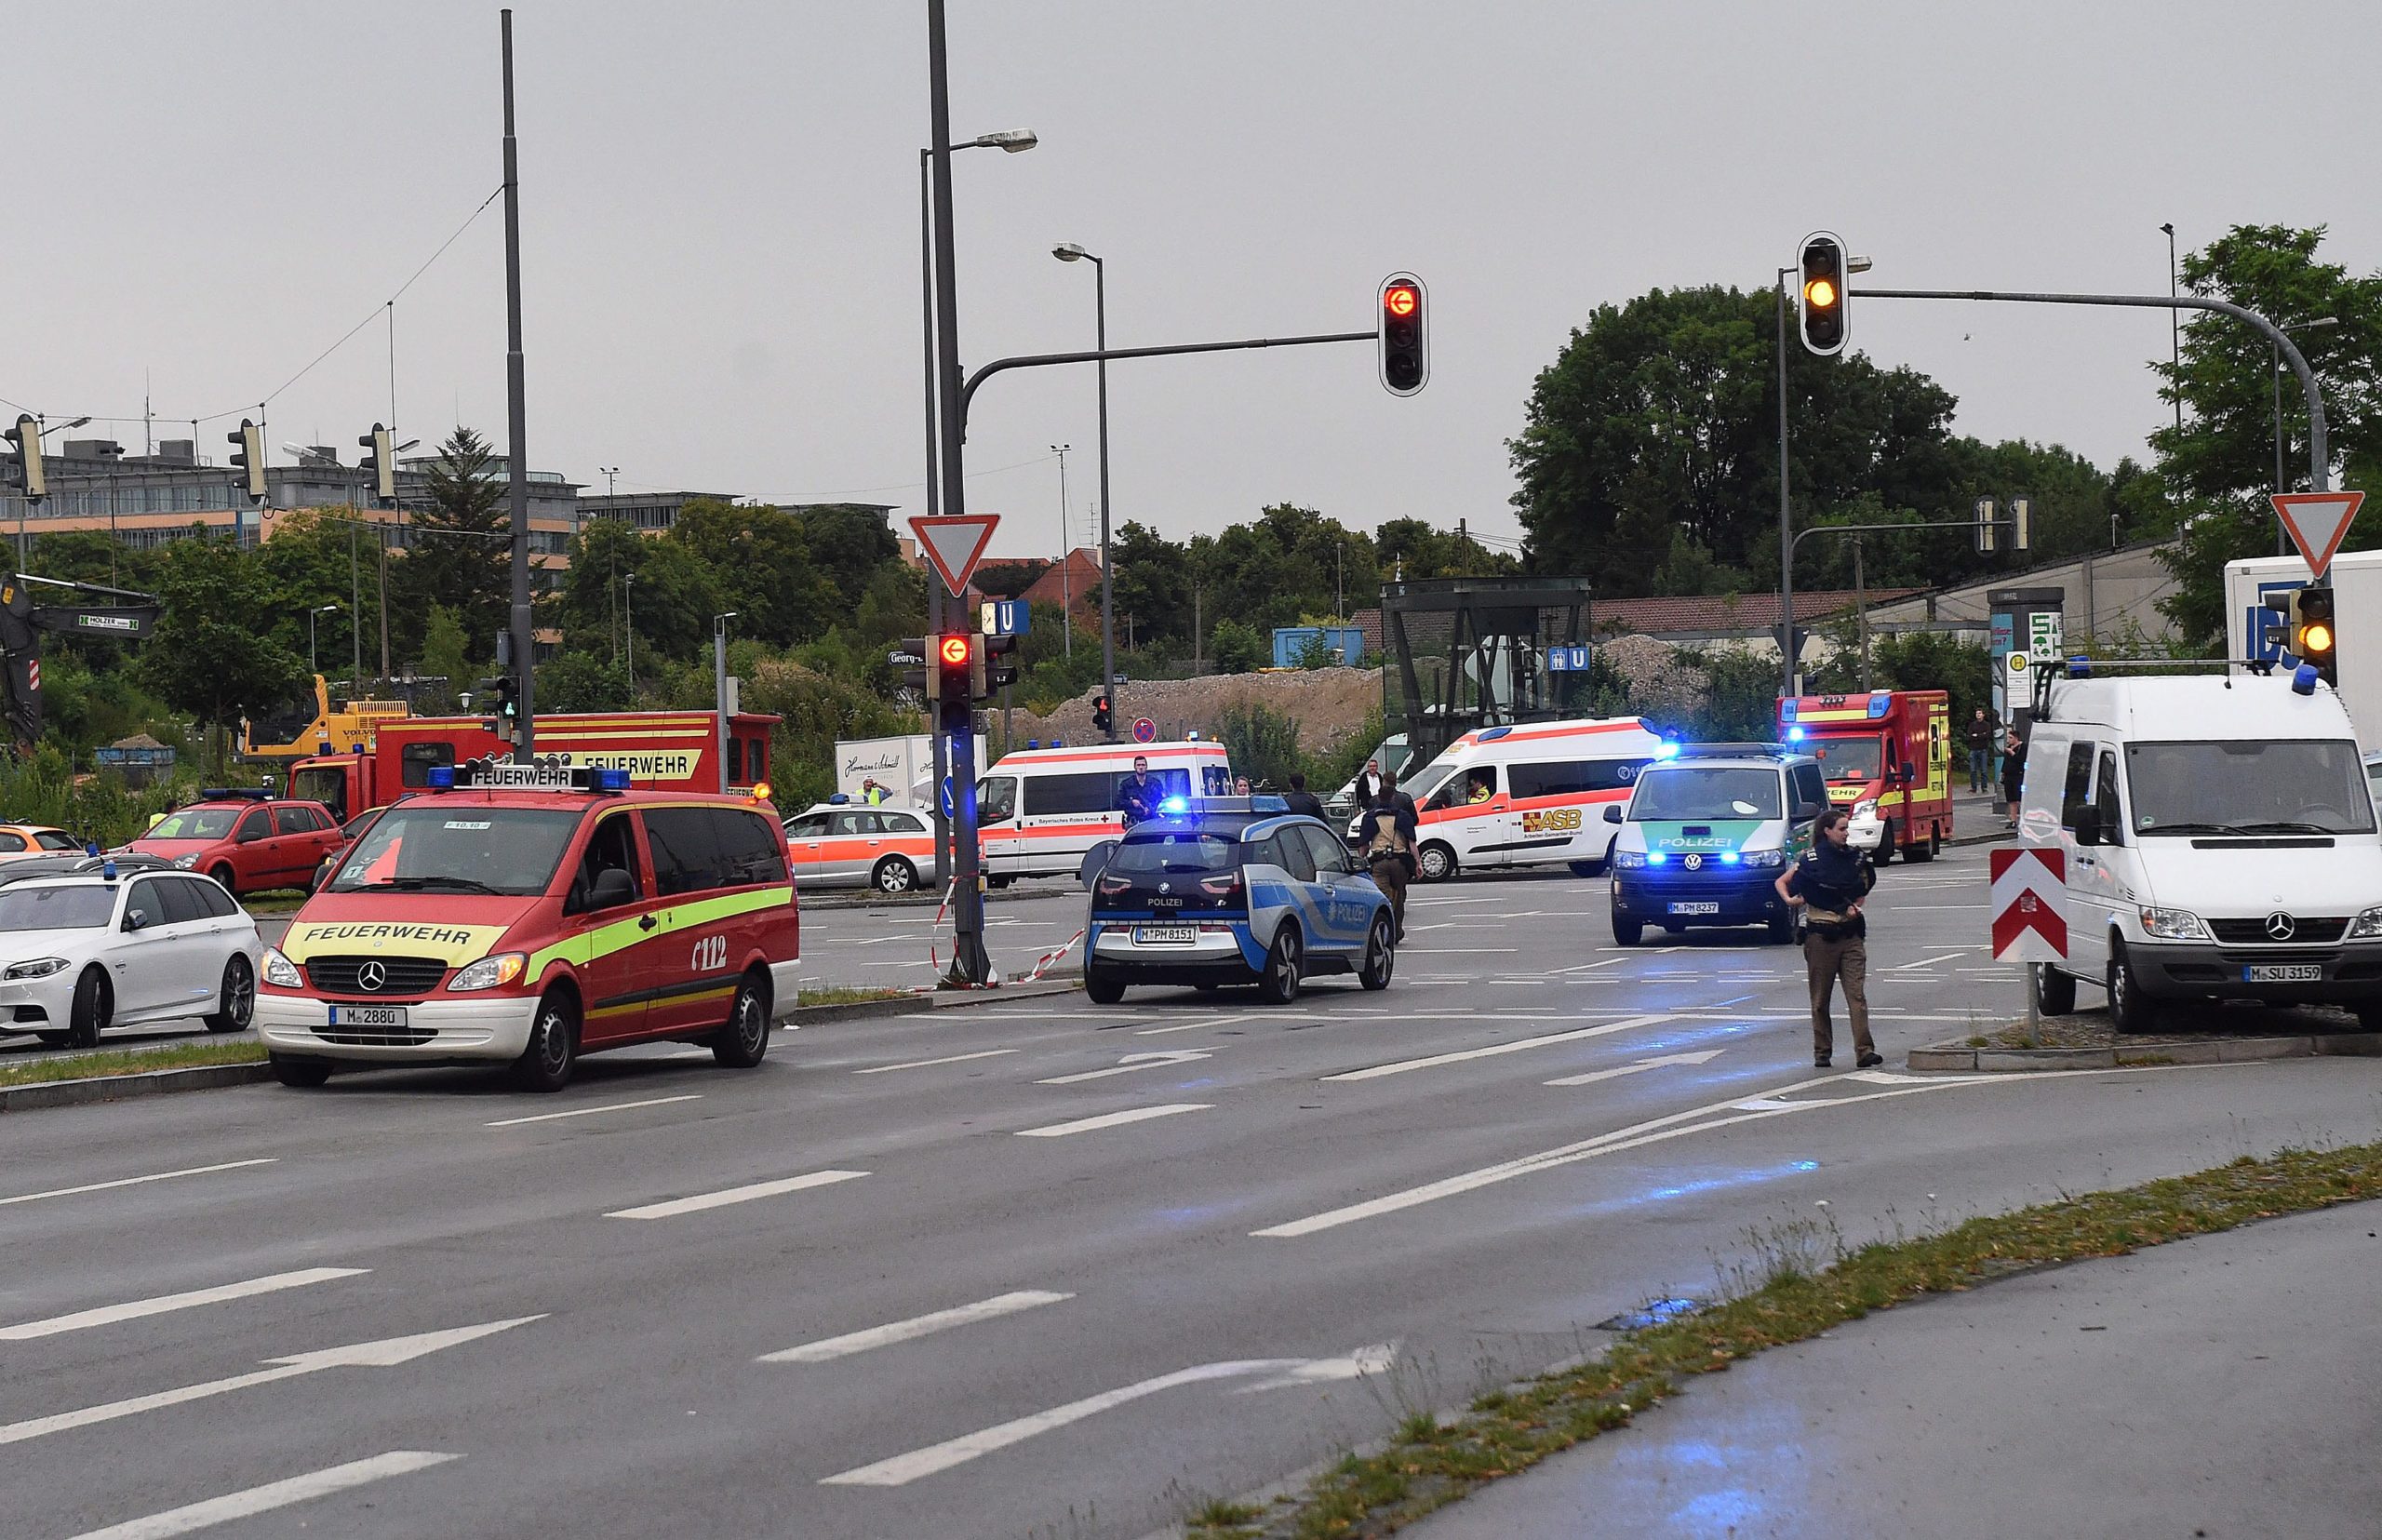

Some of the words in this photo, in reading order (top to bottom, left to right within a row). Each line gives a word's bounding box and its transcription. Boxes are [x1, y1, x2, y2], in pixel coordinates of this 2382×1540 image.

[1001, 603, 1013, 631] U
[1572, 649, 1585, 668] U
[474, 770, 569, 785] FEUERWEHR
[1538, 809, 1583, 832] ASB
[1658, 837, 1733, 848] POLIZEI
[1147, 898, 1183, 907] POLIZEI
[1695, 904, 1718, 912] 8237
[1337, 903, 1369, 923] POLIZEI
[303, 925, 472, 945] FEUERWEHR
[1154, 929, 1169, 940] PM
[1169, 929, 1193, 940] 8151
[700, 934, 727, 971] 112
[2251, 967, 2261, 981] M
[2268, 967, 2285, 980] SU
[2288, 966, 2321, 980] 3159
[347, 1010, 355, 1024] M
[364, 1010, 395, 1024] 2880
